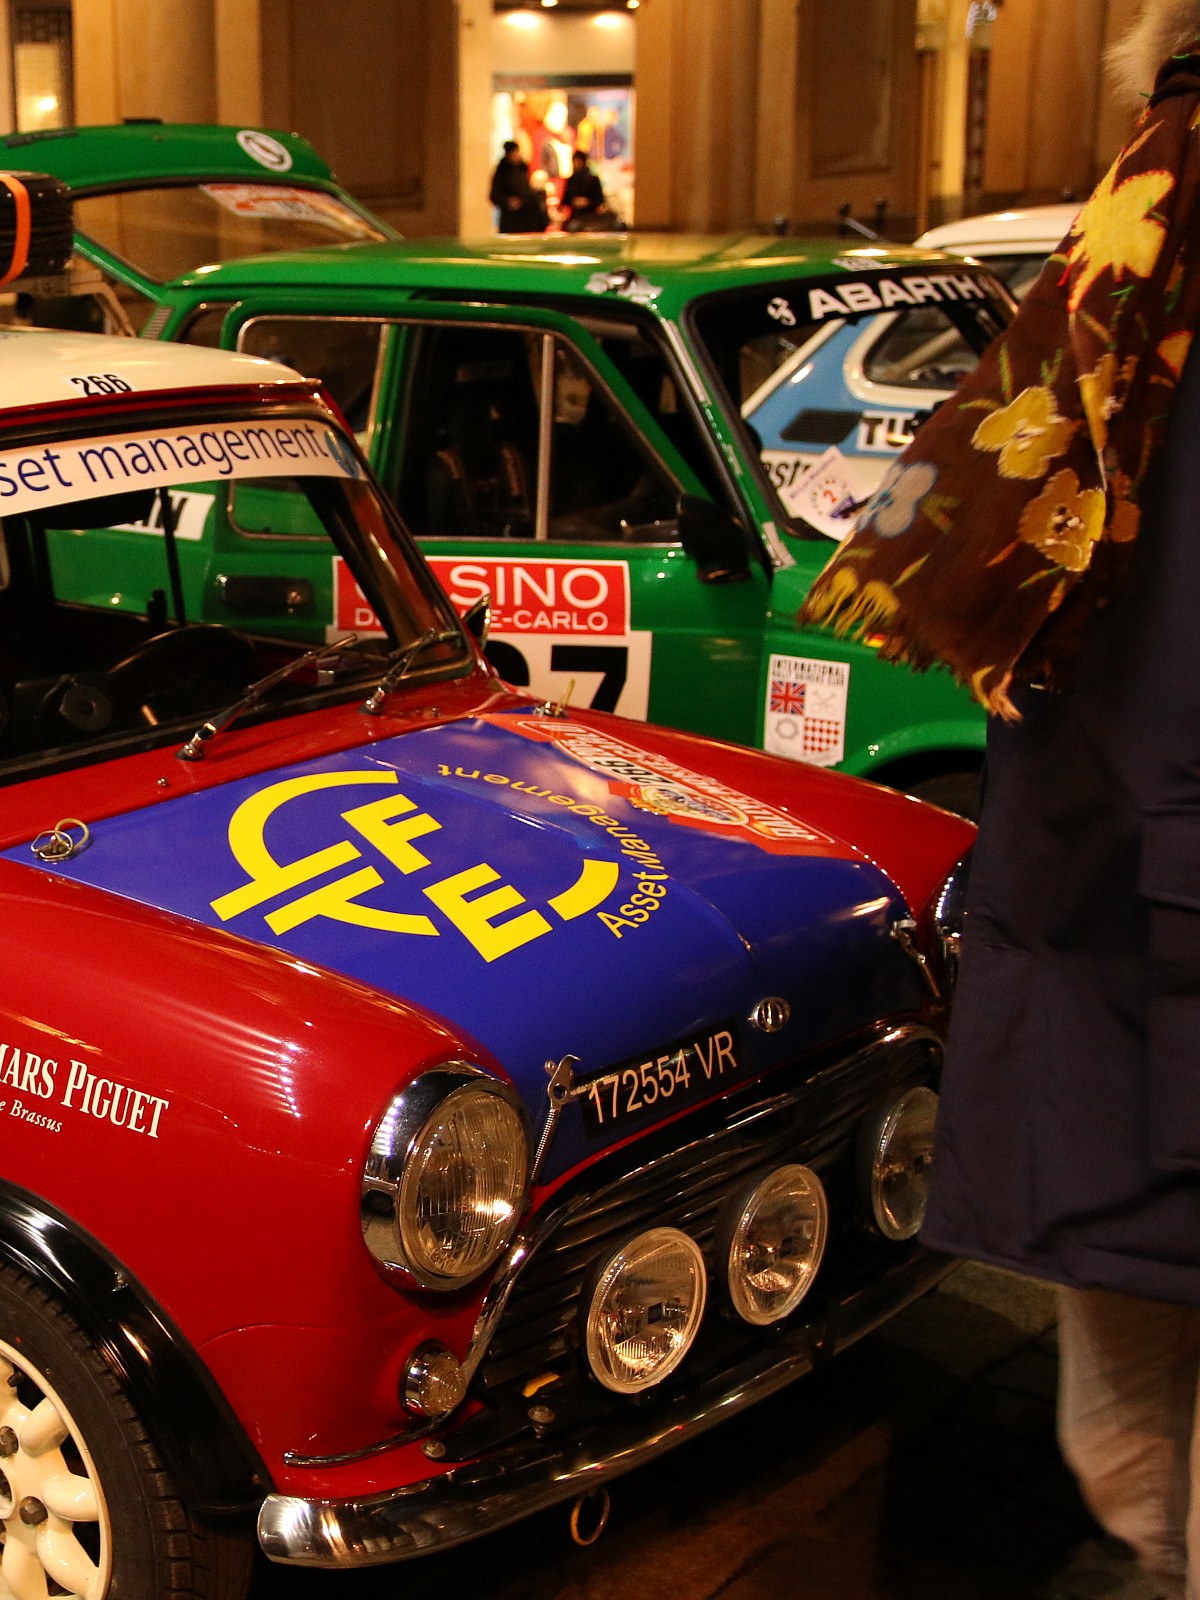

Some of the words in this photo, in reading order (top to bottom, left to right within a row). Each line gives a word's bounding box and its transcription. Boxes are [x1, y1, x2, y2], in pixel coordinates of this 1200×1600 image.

[808, 274, 986, 320] ABARTH
[71, 374, 132, 395] 266
[81, 423, 329, 482] management
[354, 565, 609, 609] SINO
[460, 608, 609, 631] E-CARLO
[593, 760, 674, 784] 266
[437, 764, 666, 871] Management
[597, 872, 669, 939] Asset
[60, 1059, 169, 1139] PIGUET
[588, 1049, 691, 1124] 172554
[694, 1030, 738, 1080] VR
[9, 1099, 63, 1133] Brassus
